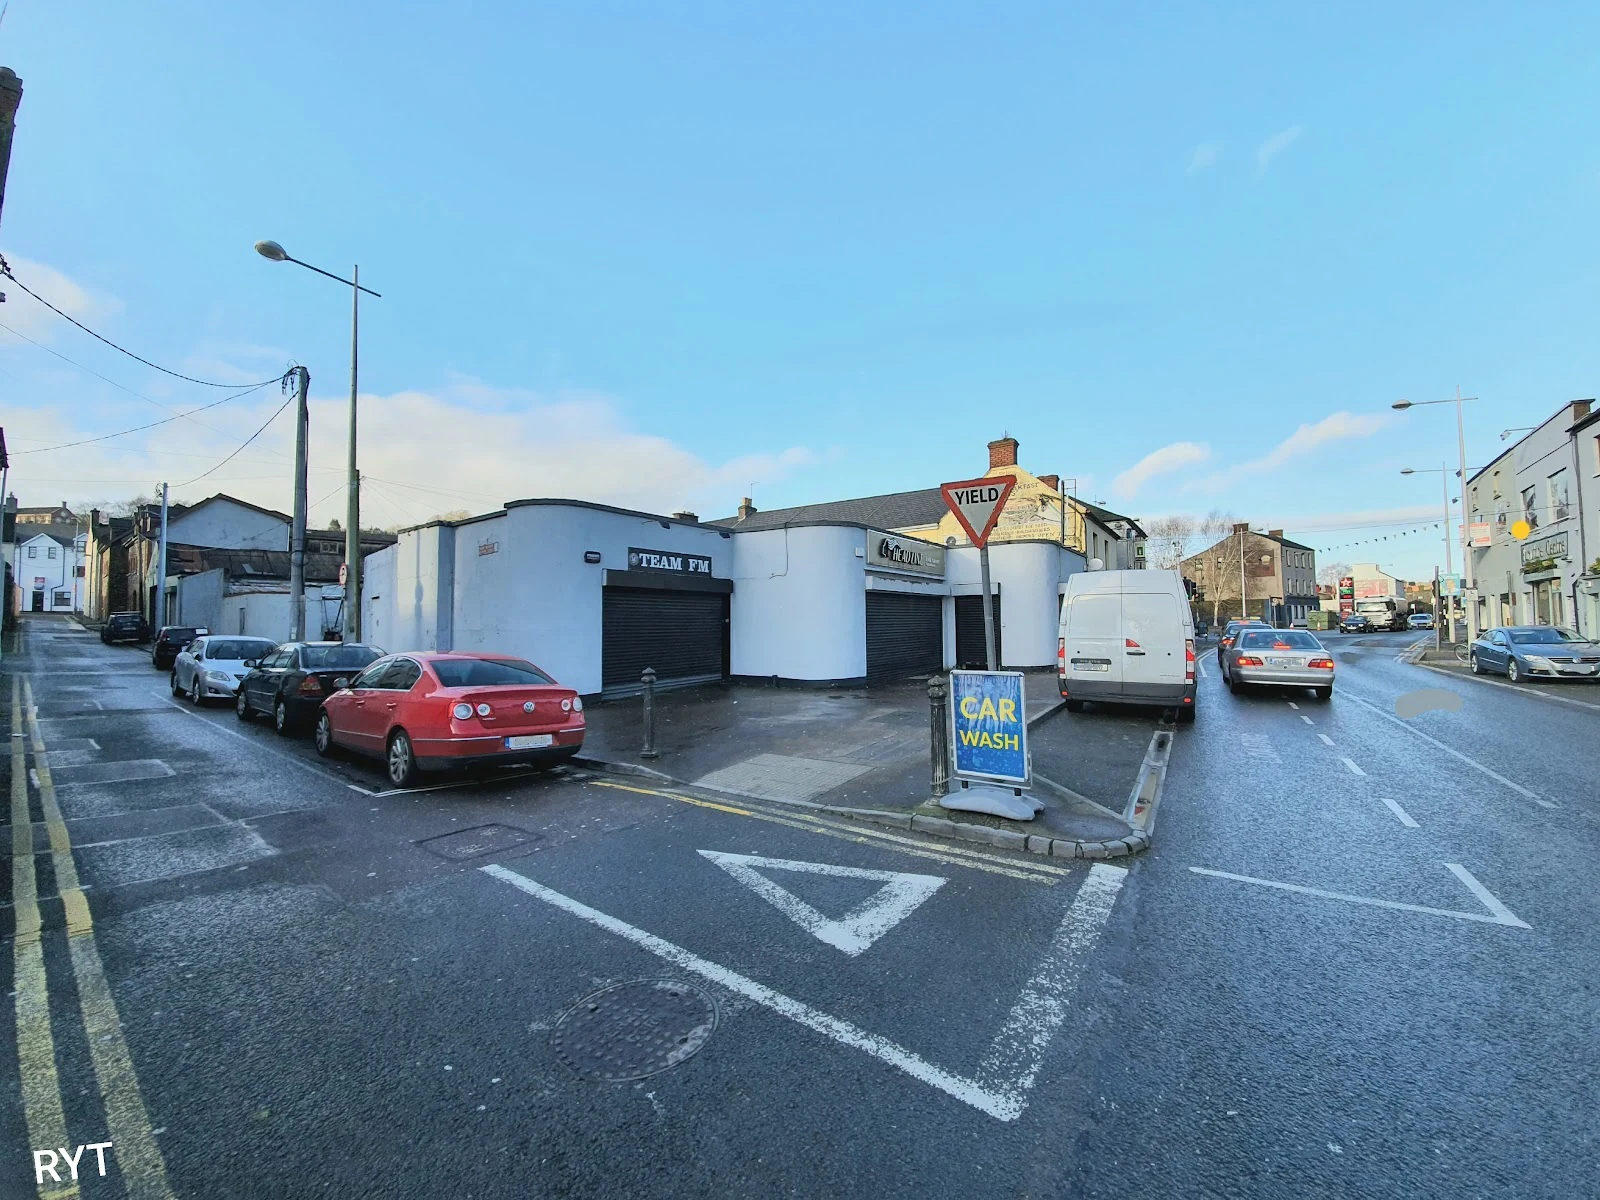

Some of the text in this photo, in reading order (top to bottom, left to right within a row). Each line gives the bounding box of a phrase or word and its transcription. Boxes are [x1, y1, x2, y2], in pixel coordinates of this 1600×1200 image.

[954, 487, 999, 506] YIELD
[638, 553, 710, 573] TEAM FM
[960, 696, 1018, 723] CAR
[959, 729, 1019, 752] WASH
